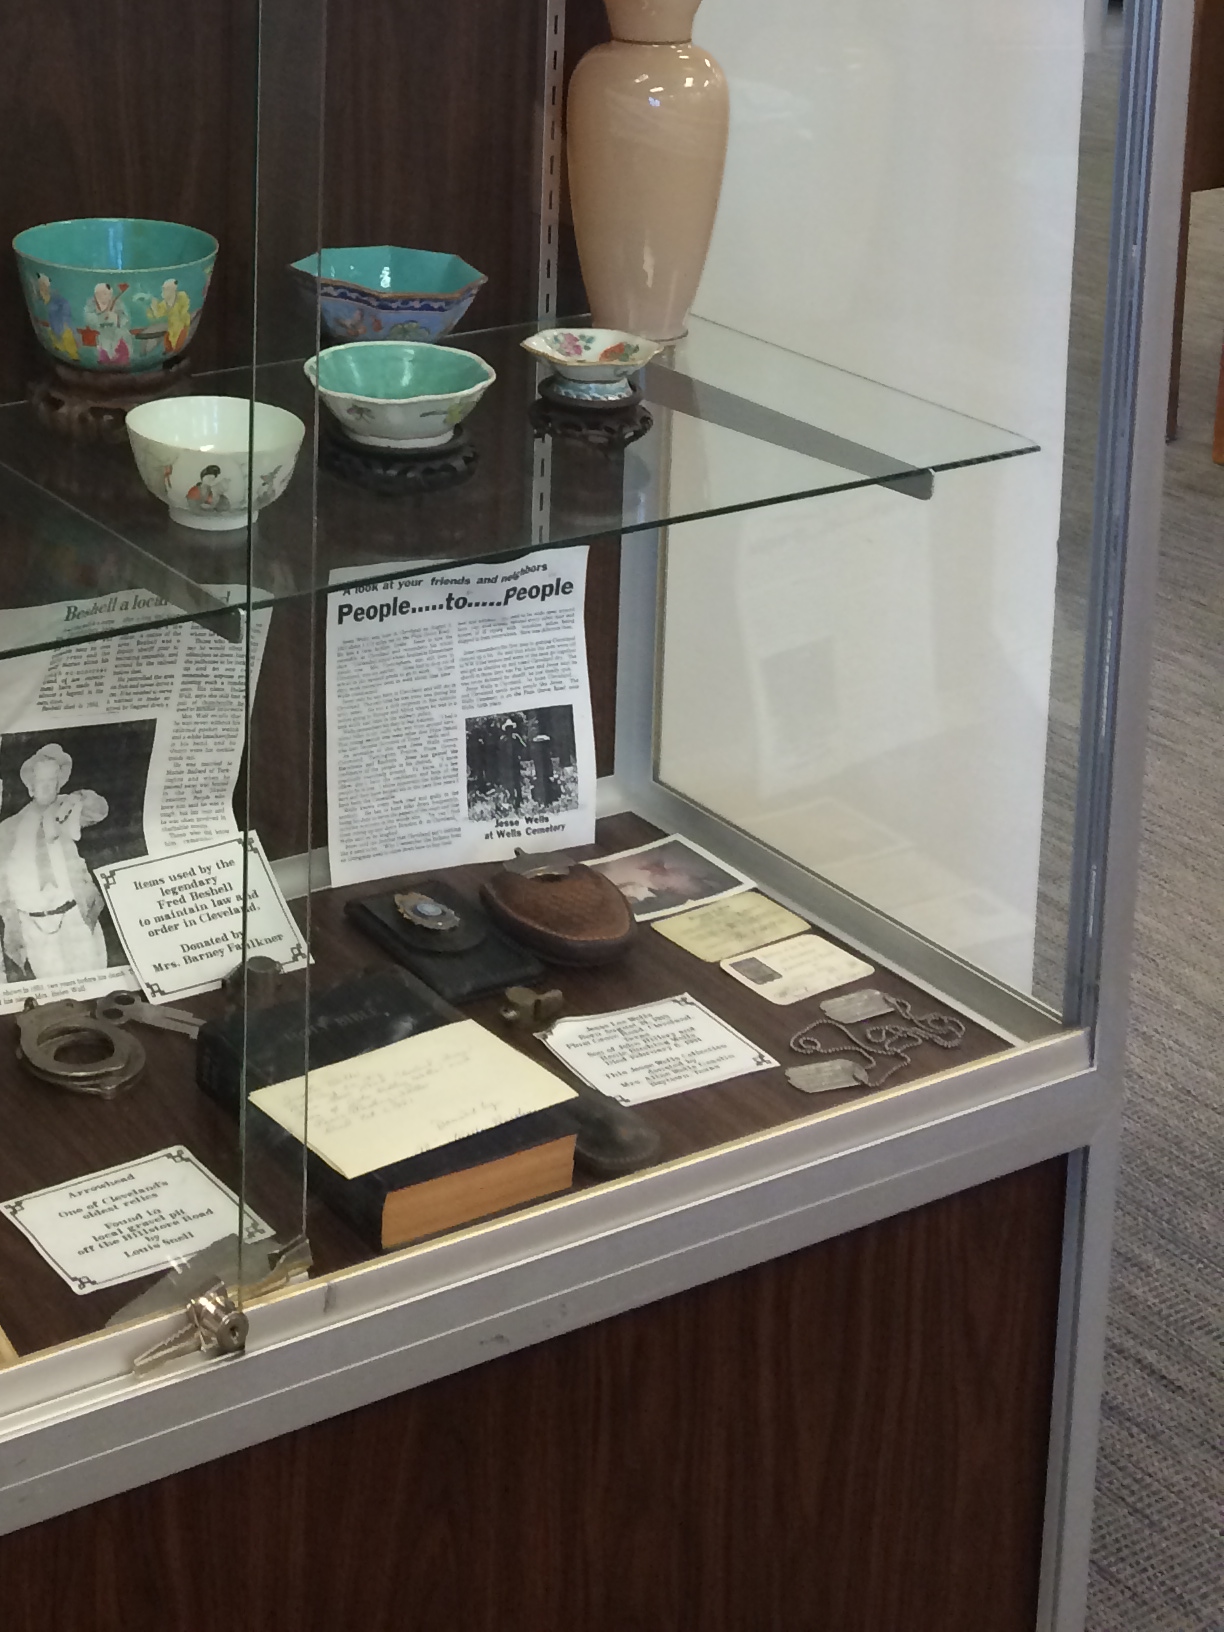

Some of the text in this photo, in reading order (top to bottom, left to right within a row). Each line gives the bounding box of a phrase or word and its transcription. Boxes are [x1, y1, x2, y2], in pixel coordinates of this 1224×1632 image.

[354, 581, 379, 594] look
[382, 580, 394, 591] at
[397, 577, 424, 590] your
[430, 575, 471, 587] friends
[476, 574, 498, 585] and
[500, 562, 548, 583] neighbors
[64, 597, 118, 622] Beshell
[119, 600, 129, 611] a
[495, 815, 550, 828] Jesse Wells
[484, 831, 494, 840] at
[496, 829, 522, 839] Wells
[133, 859, 235, 891] Items used by the
[159, 876, 217, 897] legendary
[156, 881, 234, 910] Fred Beshell
[138, 889, 260, 928] to maintain law and
[147, 923, 180, 938] order
[182, 918, 198, 928] in
[179, 932, 230, 953] Donated
[152, 961, 181, 973] Mrs.
[182, 948, 225, 965] Barney
[68, 1173, 136, 1199] Arrowhead
[58, 1181, 169, 1218] One of Cleveland's
[82, 1192, 159, 1220] oldest relics
[91, 1208, 186, 1242] local gravel pit
[103, 1212, 144, 1230] Found
[77, 1245, 95, 1256] off
[98, 1239, 120, 1249] the
[123, 1243, 161, 1258] Louis
[144, 1234, 160, 1242] by
